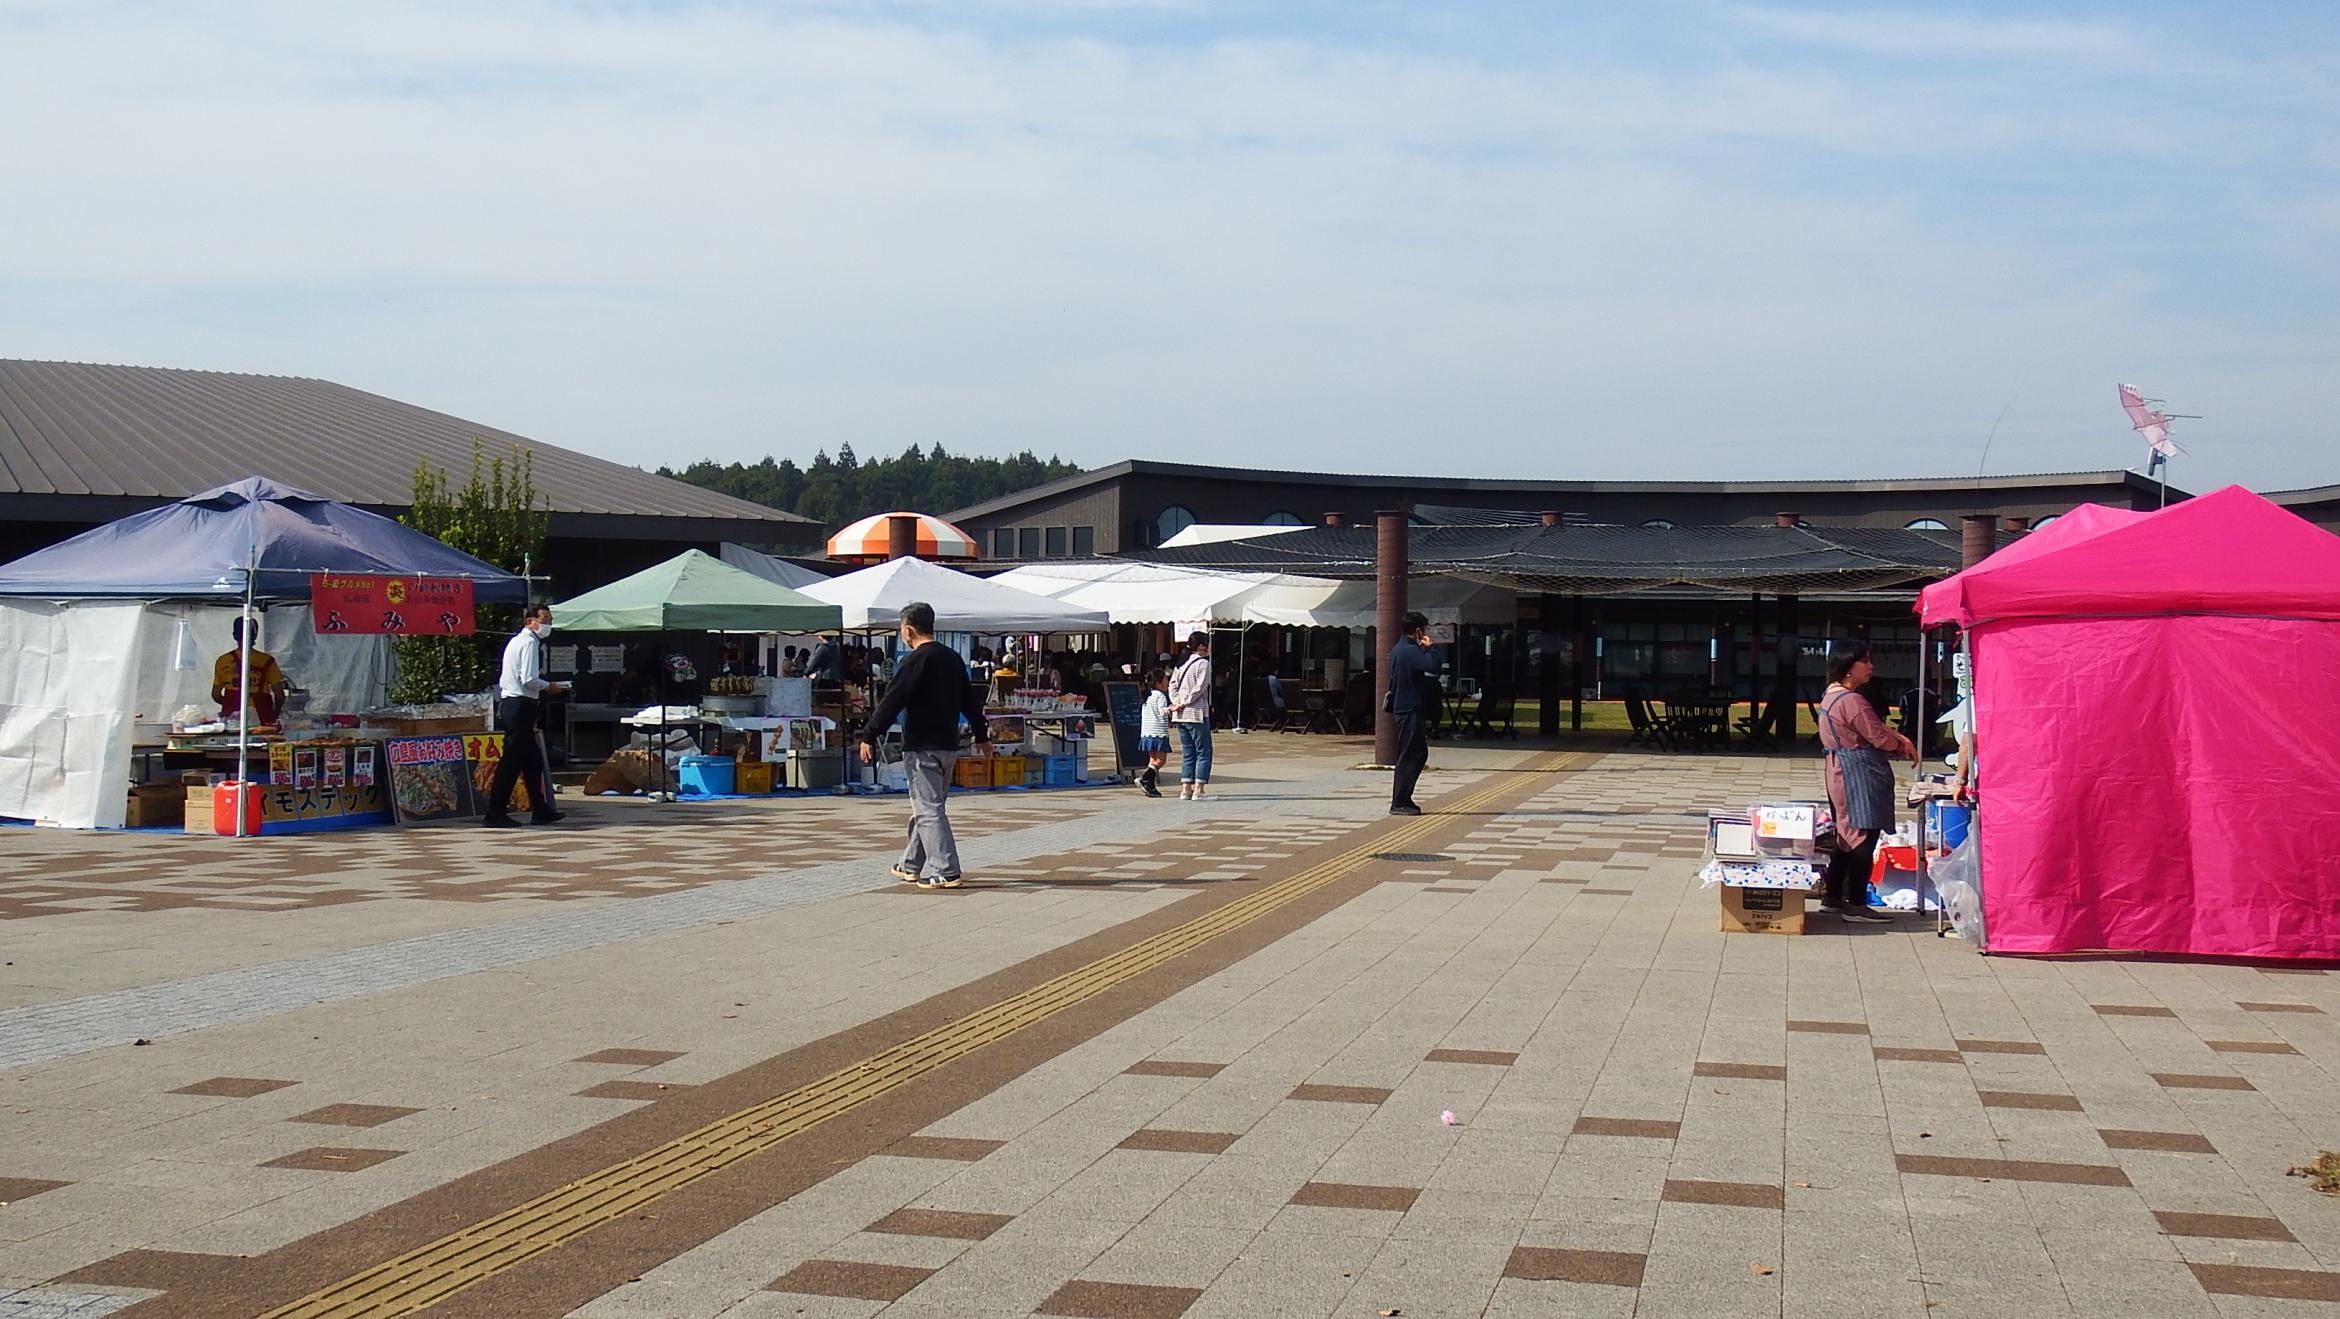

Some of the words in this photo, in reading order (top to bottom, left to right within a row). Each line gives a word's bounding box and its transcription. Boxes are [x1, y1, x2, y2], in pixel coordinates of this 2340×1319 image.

[323, 609, 461, 633] ふみや
[388, 738, 464, 765] 広島風お好み焼き
